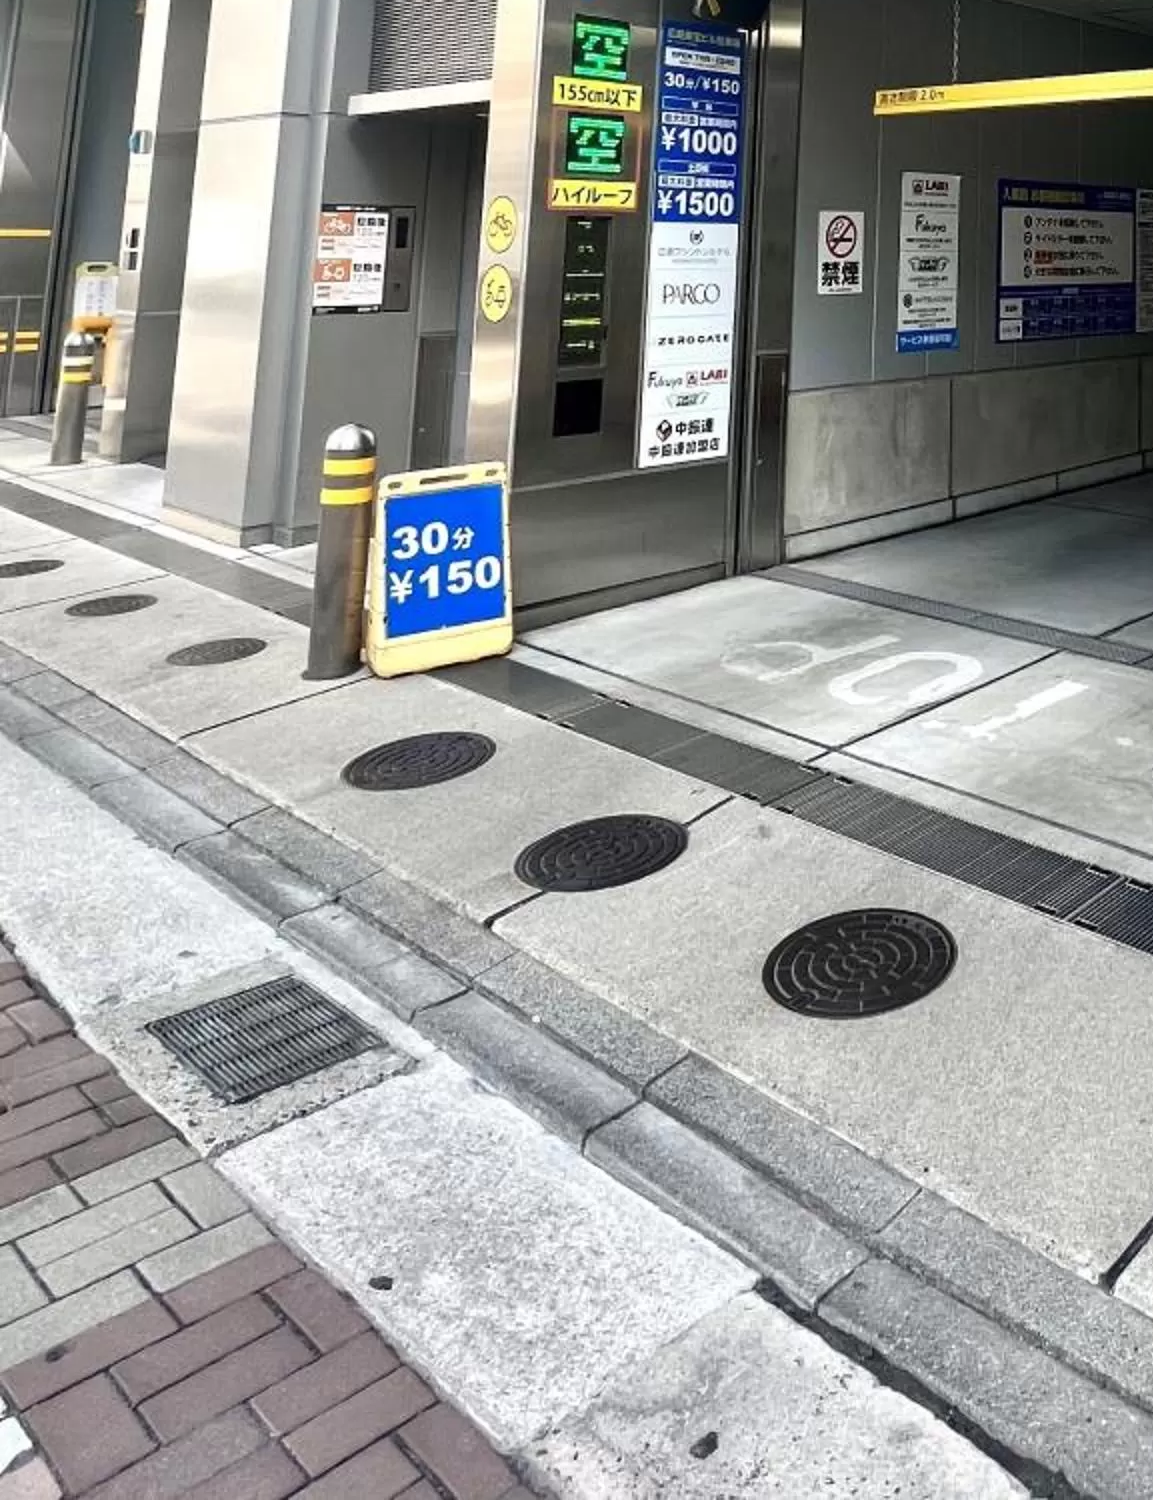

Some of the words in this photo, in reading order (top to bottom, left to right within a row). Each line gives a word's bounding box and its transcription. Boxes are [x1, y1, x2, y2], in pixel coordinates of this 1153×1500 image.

[574, 22, 629, 81] 空
[558, 83, 638, 108] 155cm以下
[567, 116, 625, 174] 空
[661, 126, 737, 156] ¥1000
[552, 185, 634, 204] ハイルーフ
[657, 191, 734, 217] ¥1500
[821, 261, 860, 286] 禁煙
[662, 283, 721, 305] PARCO
[391, 522, 475, 559] 30分
[389, 556, 501, 605] ¥150
